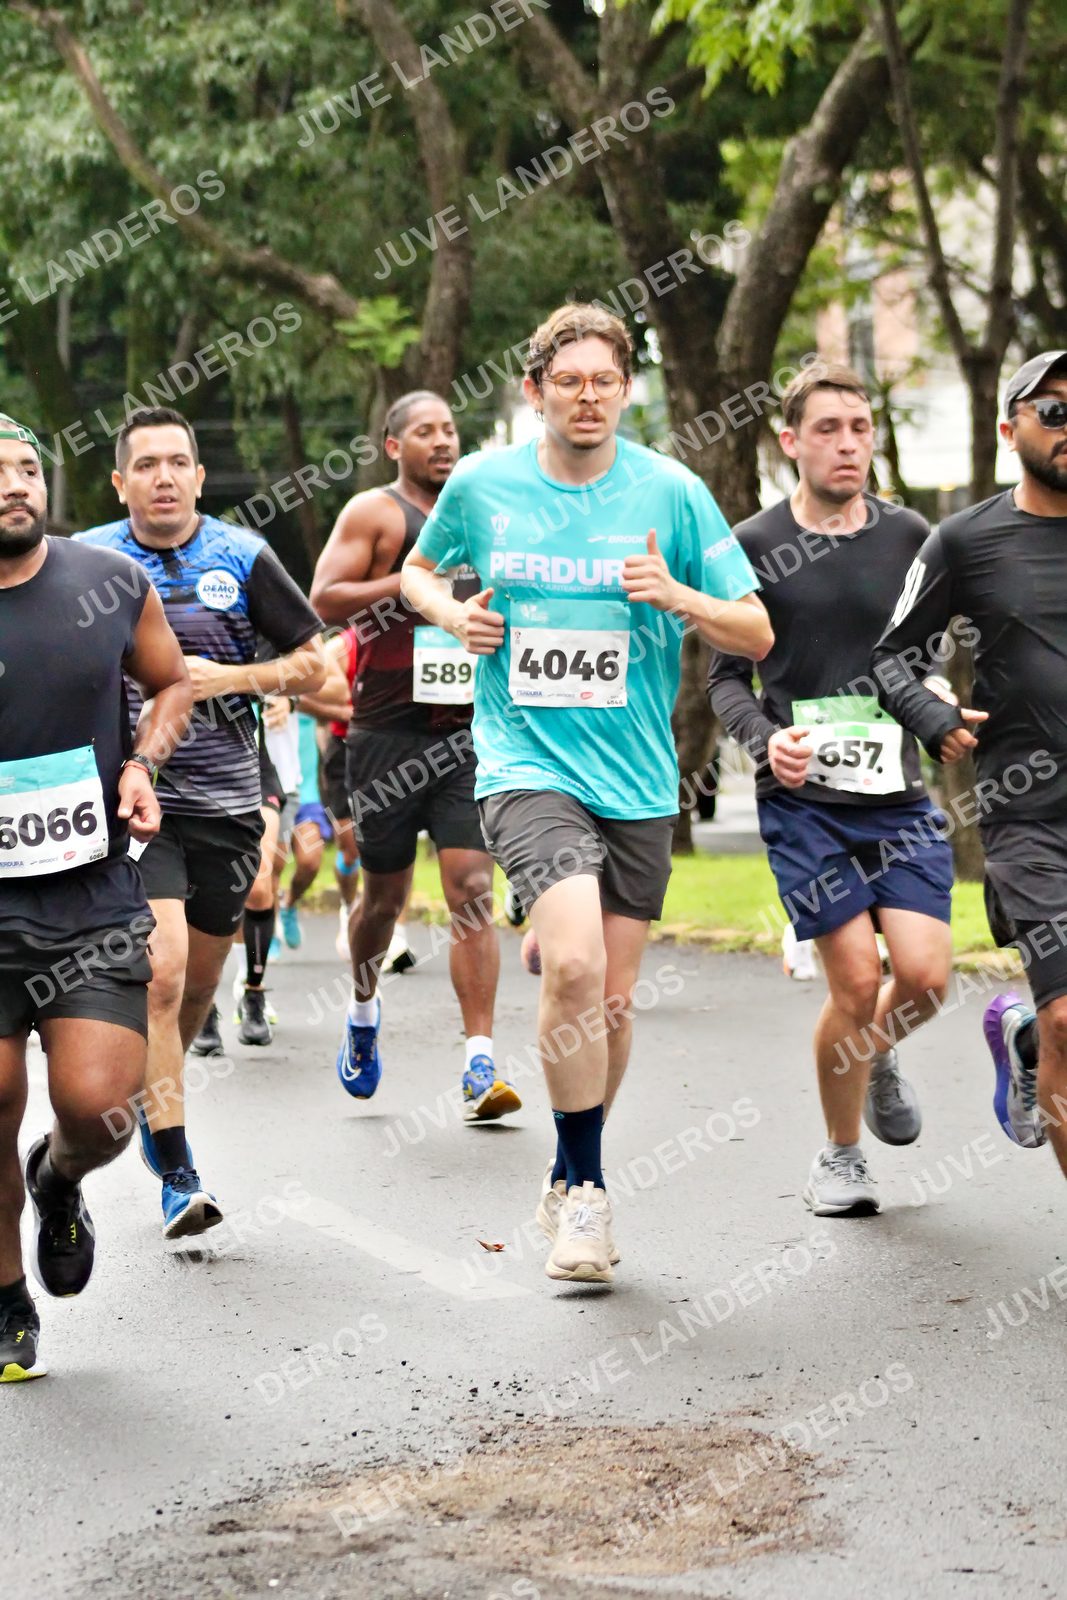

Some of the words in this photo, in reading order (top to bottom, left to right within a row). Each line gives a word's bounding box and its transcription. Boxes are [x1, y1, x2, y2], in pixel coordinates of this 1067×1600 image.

[607, 535, 647, 544] BROOK
[490, 552, 626, 586] PERDUR
[202, 584, 235, 594] DEMO
[207, 592, 233, 600] TEAM
[420, 662, 472, 684] 589
[518, 648, 620, 682] 4046
[817, 740, 884, 770] 657
[0, 801, 98, 851] 6066
